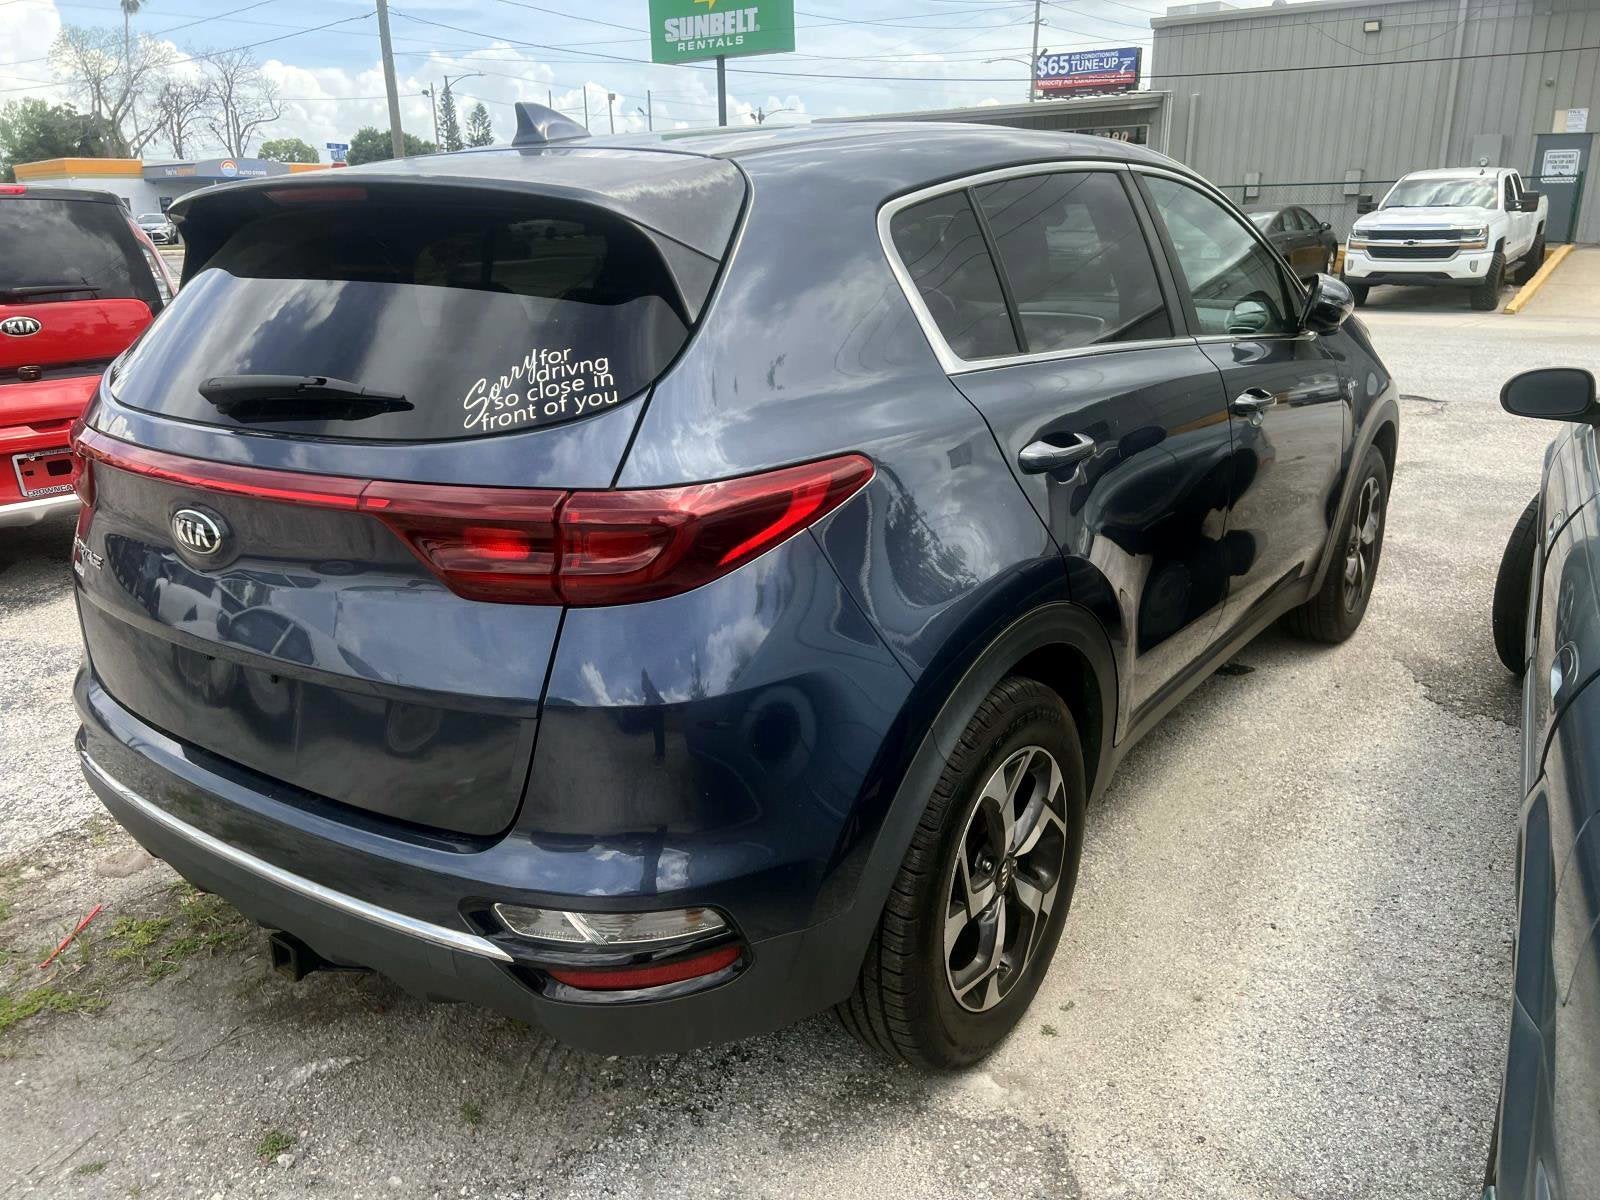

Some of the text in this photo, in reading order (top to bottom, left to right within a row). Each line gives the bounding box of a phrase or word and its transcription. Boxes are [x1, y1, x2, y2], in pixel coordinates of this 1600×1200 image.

[664, 7, 758, 43] SUNBELT
[677, 35, 744, 52] RENTALS
[1081, 51, 1119, 59] CONDITIONING
[1037, 55, 1069, 78] $65
[1070, 58, 1119, 71] TUNE-UP
[5, 319, 37, 334] KIA
[539, 348, 572, 366] for
[536, 357, 609, 382] drivng
[464, 349, 537, 429] Sorry
[494, 371, 614, 410] so close in
[481, 390, 618, 431] front of you
[175, 517, 212, 548] KIA
